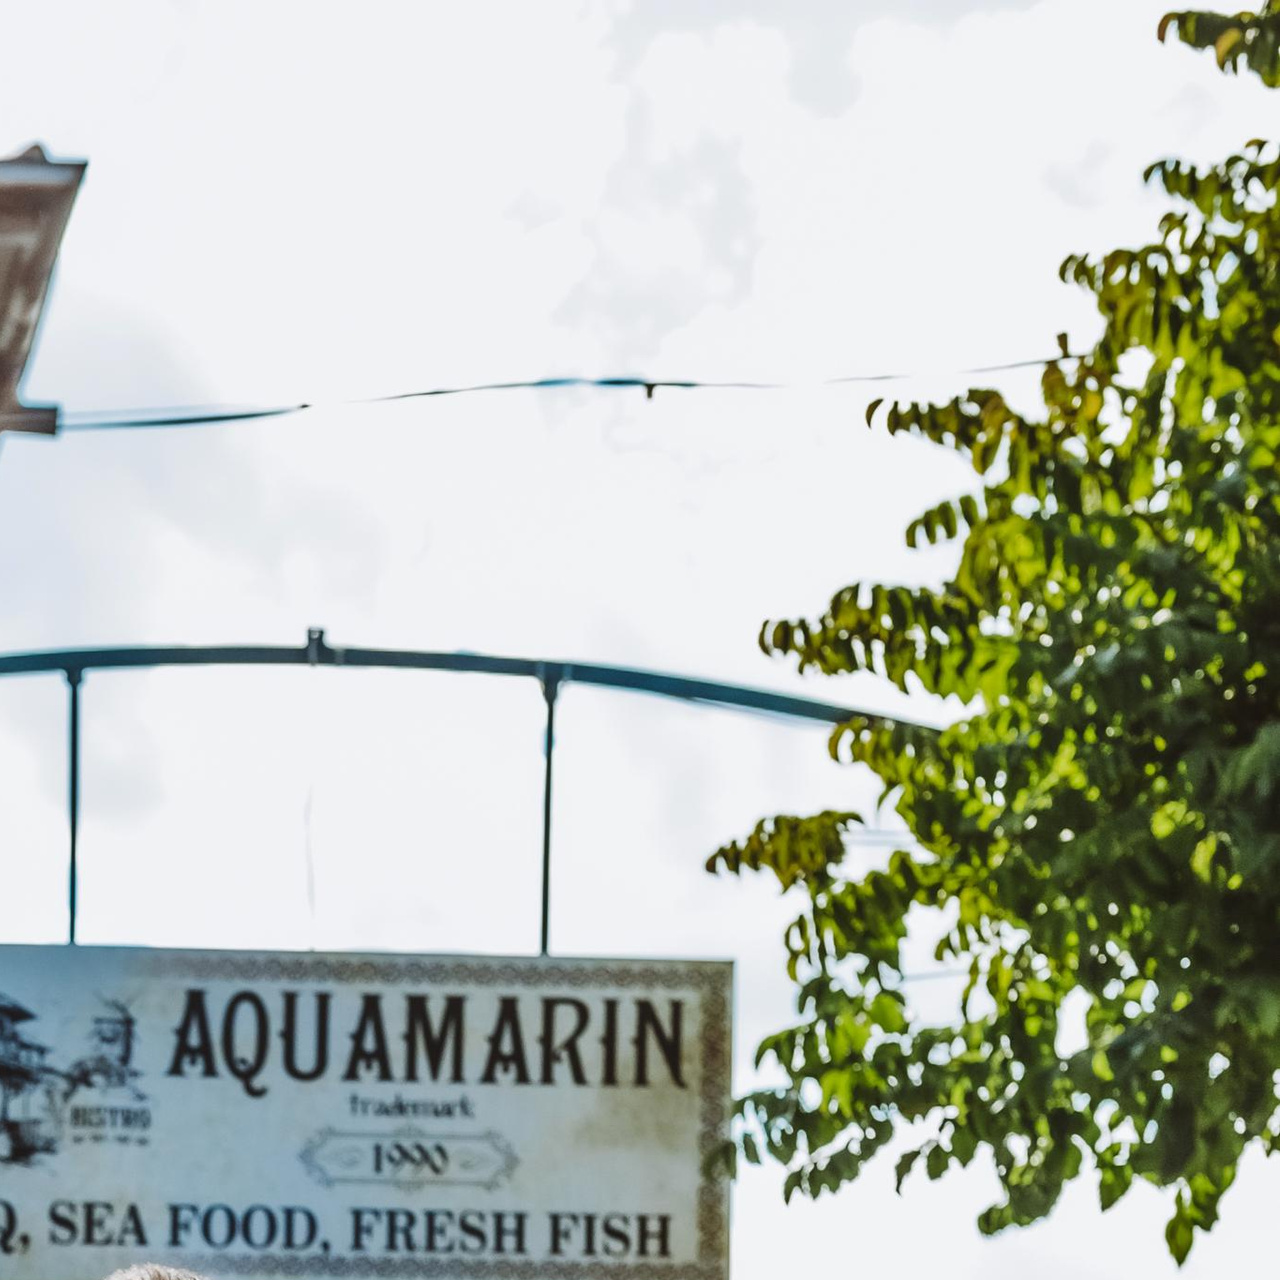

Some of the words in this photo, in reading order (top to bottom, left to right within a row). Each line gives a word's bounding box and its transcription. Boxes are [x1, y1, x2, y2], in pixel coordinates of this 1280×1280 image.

[166, 988, 688, 1097] AQUAMARIN
[70, 1106, 151, 1128] BISTRO
[48, 1201, 148, 1246] SEA
[167, 1204, 331, 1253] FOOD,
[350, 1207, 527, 1255] FRESH
[548, 1212, 672, 1257] FISH
